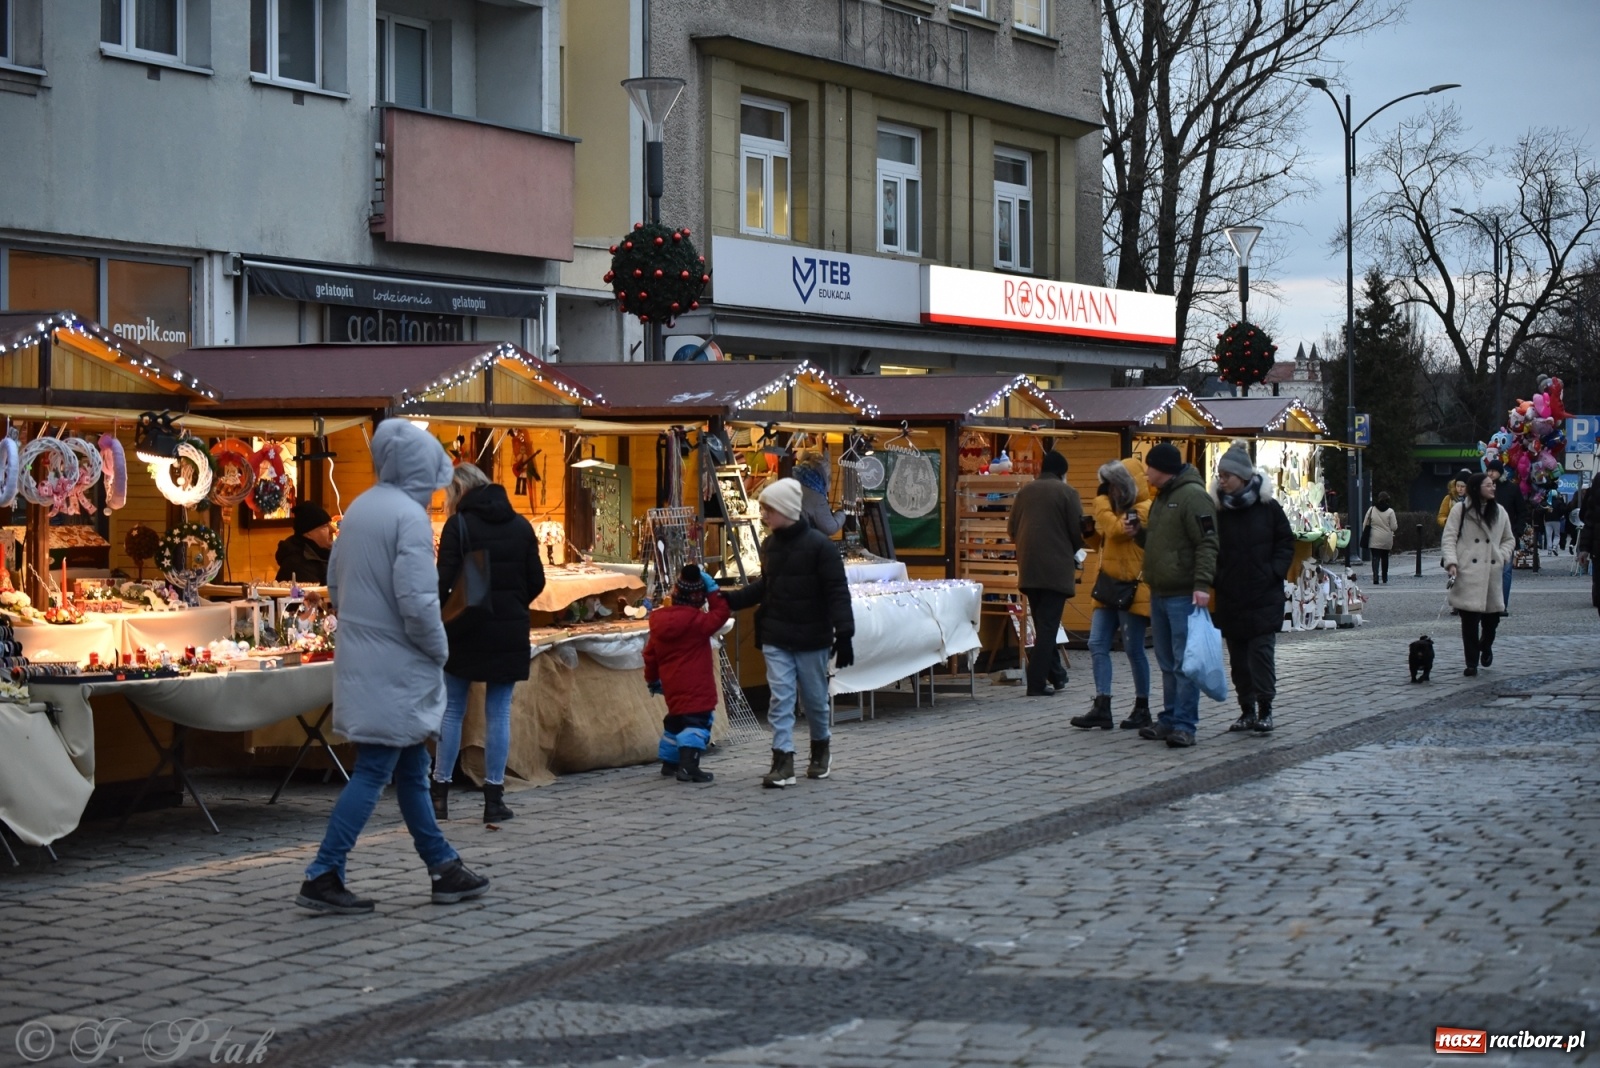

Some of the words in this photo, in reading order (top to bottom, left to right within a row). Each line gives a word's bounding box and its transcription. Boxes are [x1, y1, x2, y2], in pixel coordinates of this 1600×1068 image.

[819, 259, 851, 286] TEB
[315, 283, 354, 300] gelatopiu
[373, 288, 433, 305] lodziarnia
[452, 296, 487, 311] gelatopiu
[819, 289, 851, 301] EDUKACJA
[1005, 280, 1118, 326] ROSSMANN
[113, 317, 186, 344] empik.com
[347, 309, 458, 343] gelatopiu
[1355, 415, 1365, 429] P
[1573, 418, 1589, 442] P
